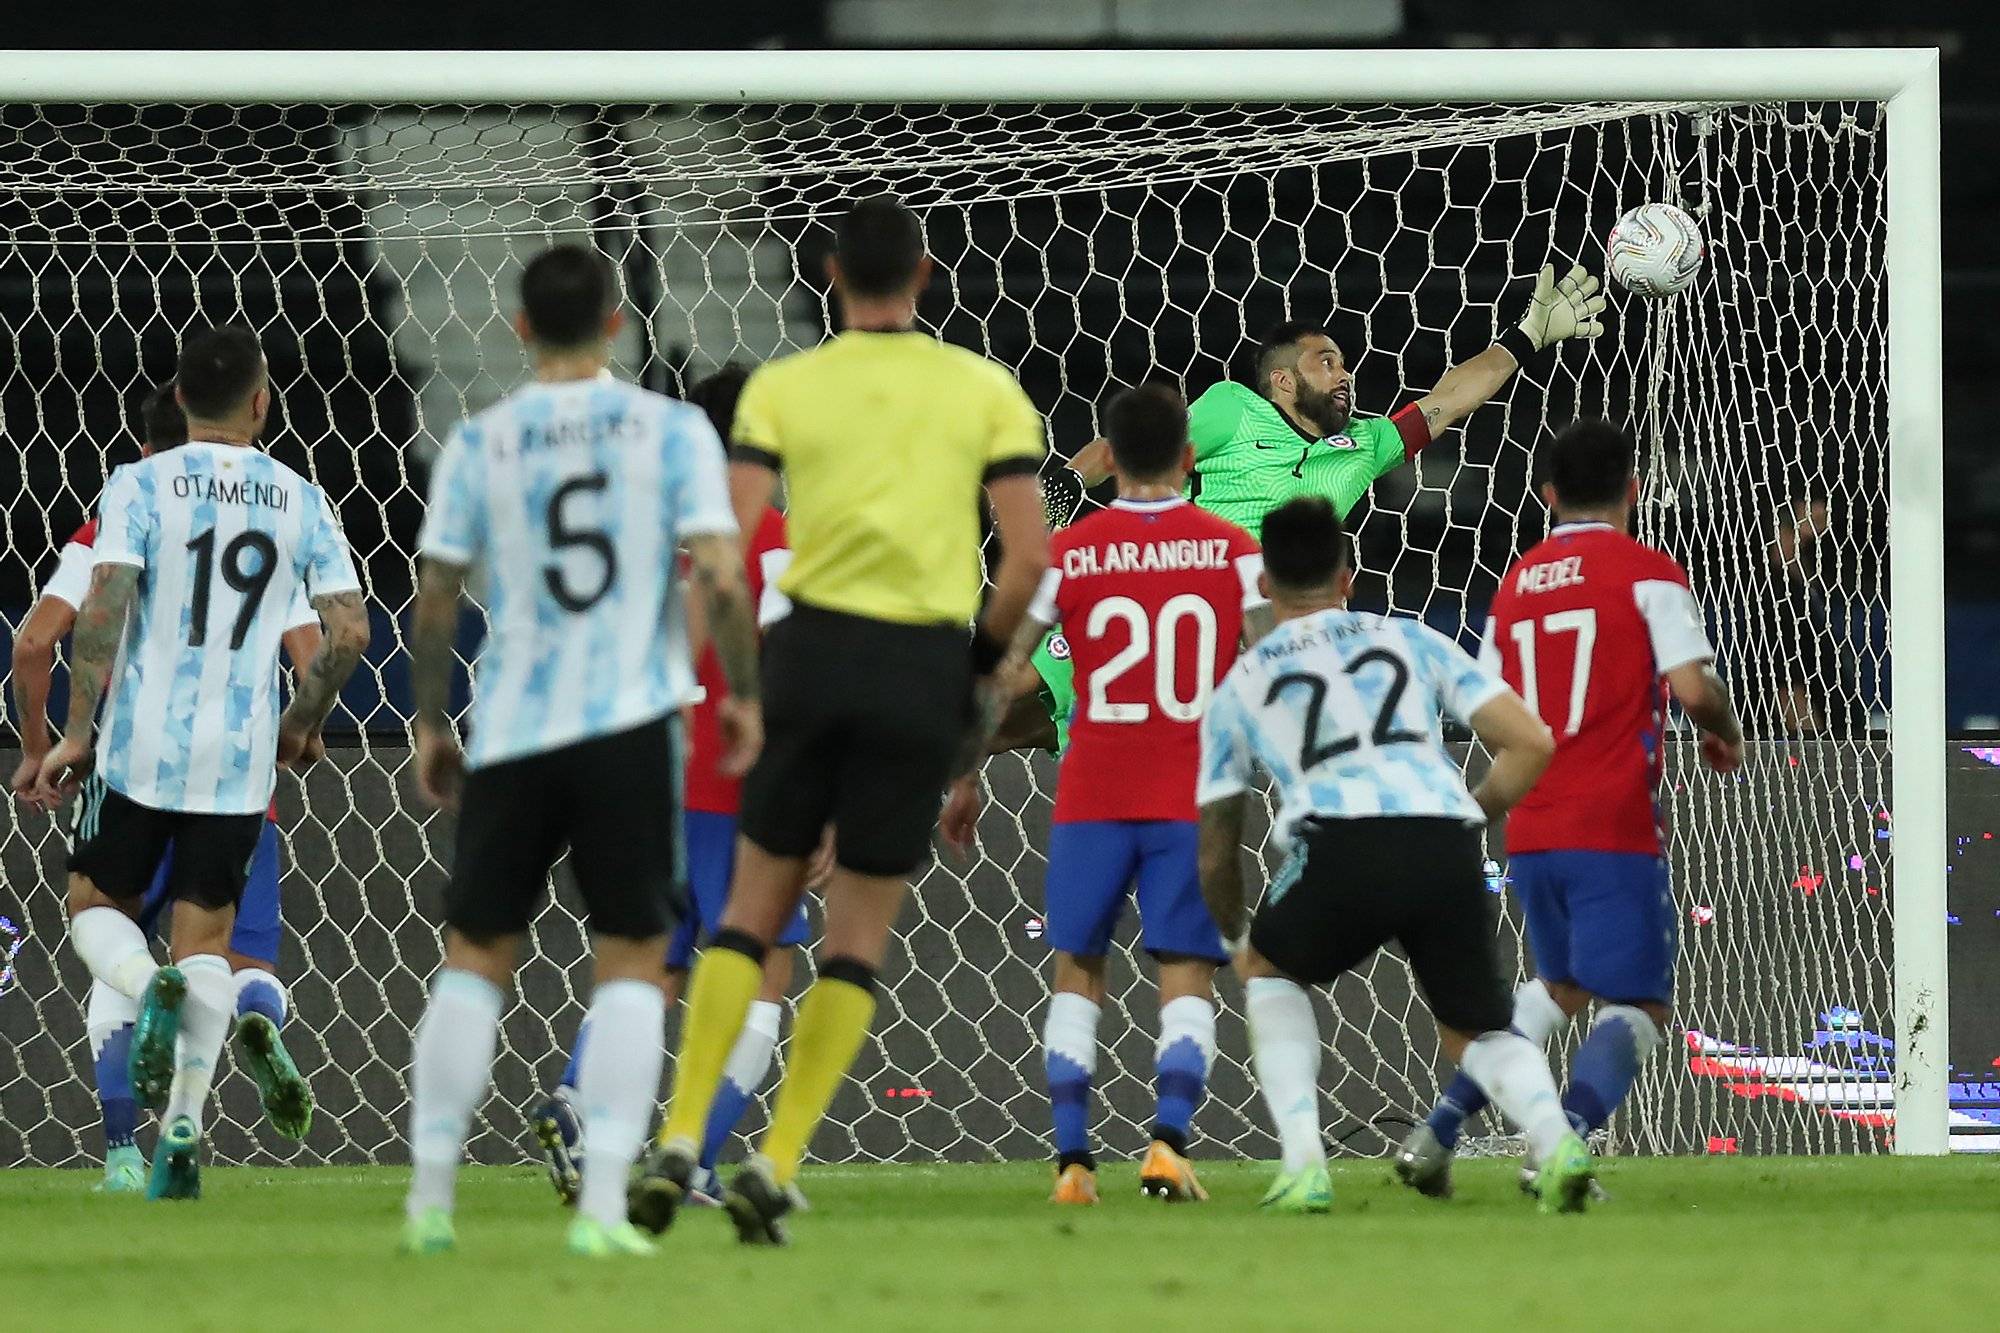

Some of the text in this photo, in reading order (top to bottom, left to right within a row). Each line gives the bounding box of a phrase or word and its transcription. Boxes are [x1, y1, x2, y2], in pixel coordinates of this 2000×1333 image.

[173, 473, 288, 513] OTAMENDI
[544, 472, 619, 615] 5
[185, 526, 279, 650] 19
[1063, 538, 1231, 580] CH.ARANGUIZ
[1516, 555, 1585, 598] MEDEL
[1087, 593, 1218, 723] 20
[1263, 646, 1428, 773] 22
[1511, 607, 1597, 736] 17
